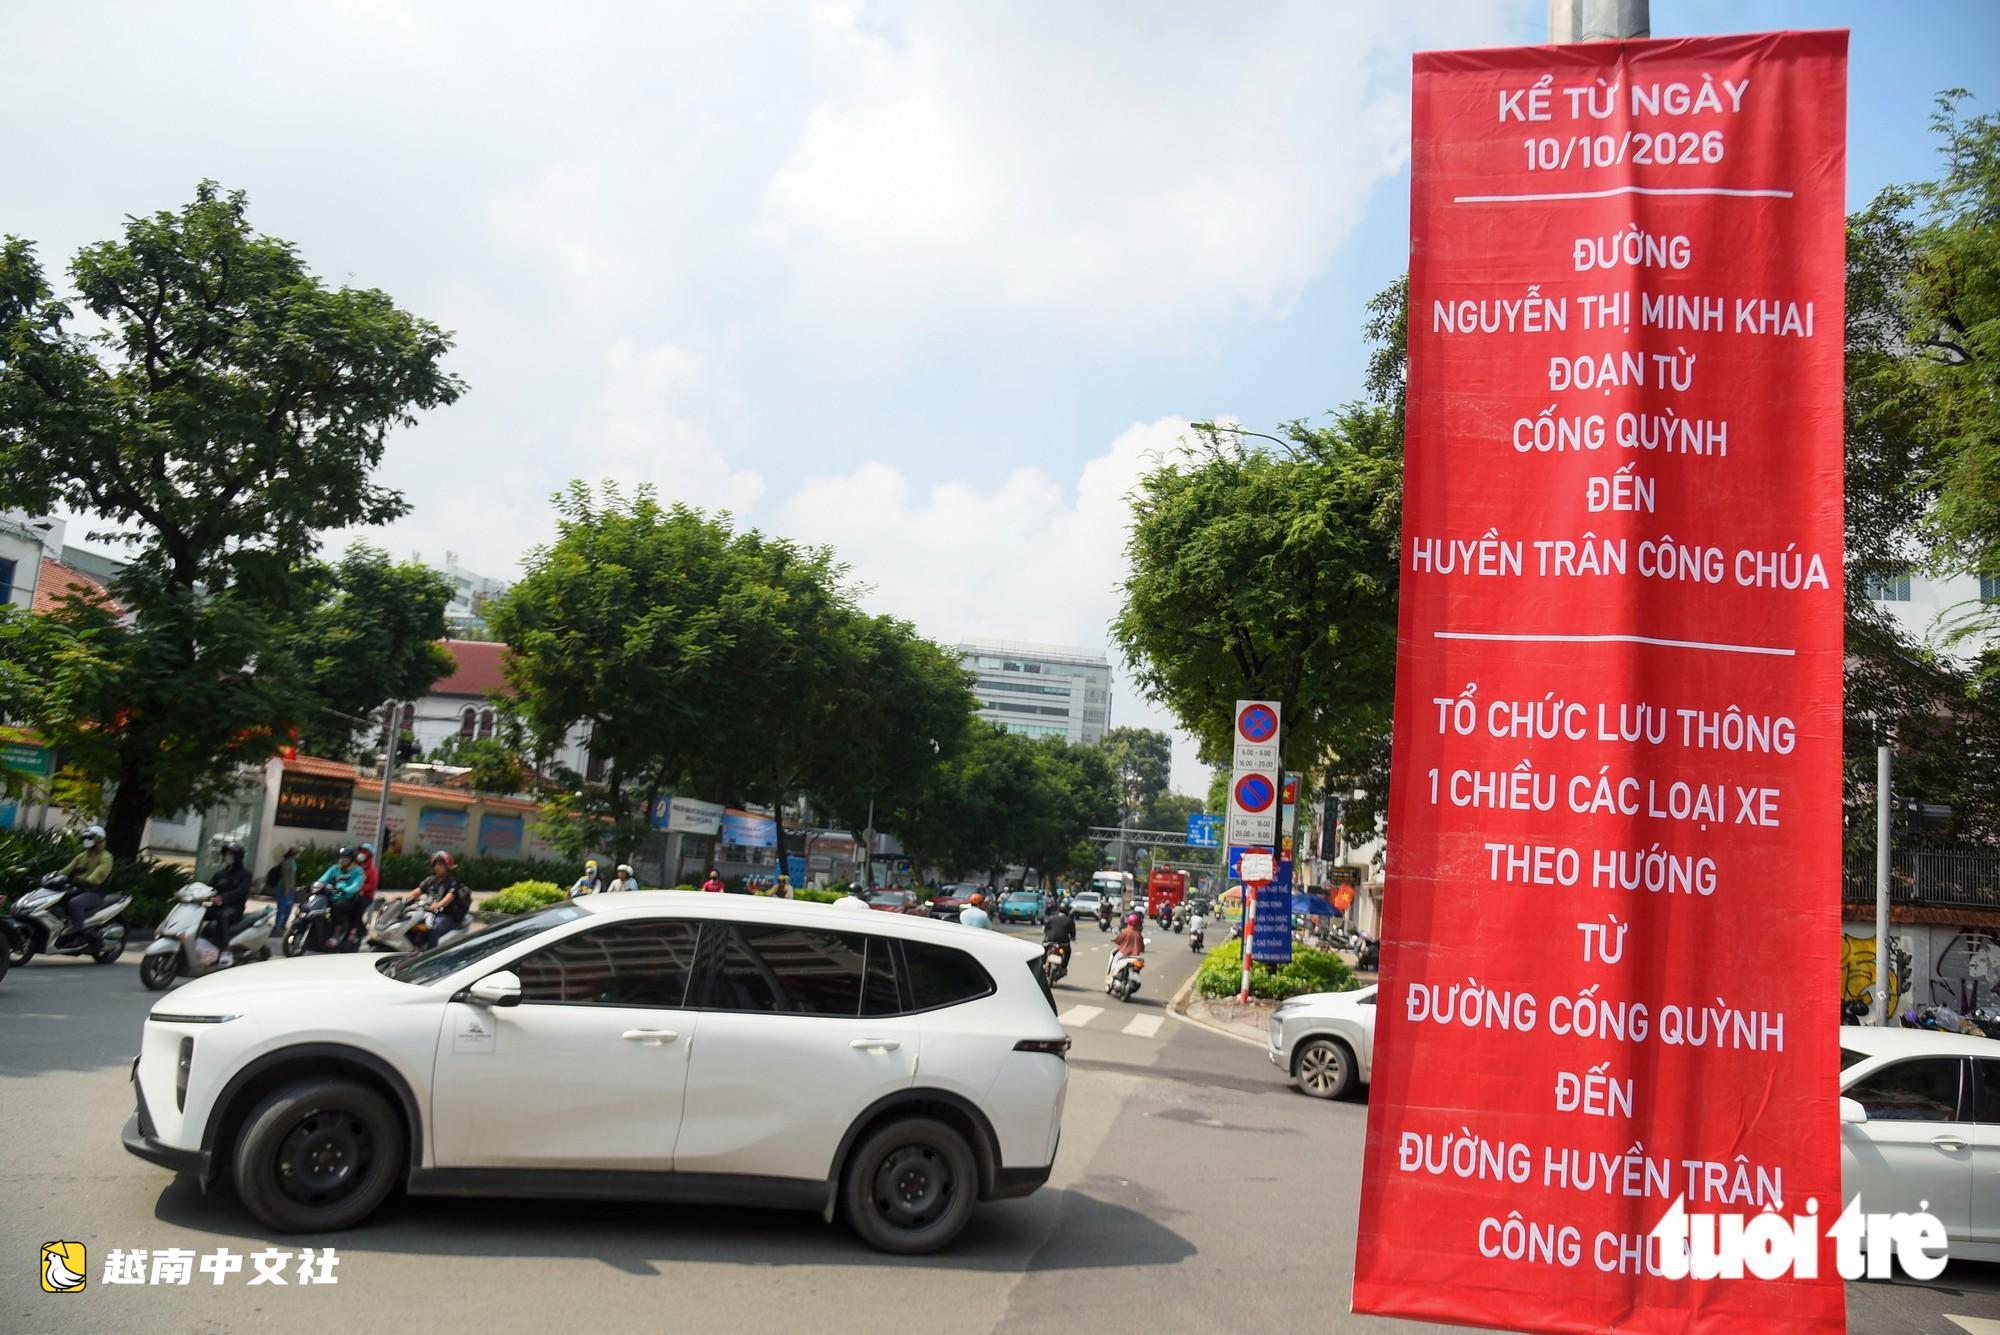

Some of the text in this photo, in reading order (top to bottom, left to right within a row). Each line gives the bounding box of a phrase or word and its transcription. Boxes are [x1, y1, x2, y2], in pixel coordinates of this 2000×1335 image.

[1498, 73, 1748, 122] KỂ TỪ NGÀY
[1524, 130, 1724, 171] 10/10/2026
[1573, 223, 1690, 271] ĐƯỜNG
[1434, 285, 1813, 337] NGUYỄN THỊ MINH KHAI
[1549, 347, 1695, 396] ĐOẠN TỪ
[1514, 404, 1726, 456] CỐNG QUỲNH
[1586, 462, 1654, 512] ĐẾN
[1413, 528, 1829, 589] HUYỀN TRÂN CÔNG CHÚA
[1433, 682, 1795, 754] TỔ CHỨC LƯU THÔNG
[1428, 758, 1779, 830] 1 CHIỀU CÁC LOẠI XE
[1485, 843, 1716, 895] THEO HƯỚNG
[1577, 914, 1627, 964] TỪ
[1407, 977, 1783, 1051] ĐƯỜNG CỐNG QUỲNH
[1555, 1062, 1632, 1117] ĐẾN
[1399, 1127, 1782, 1207] ĐƯỜNG HUYỀN TRÂN
[1479, 1210, 1580, 1266] CÔNG
